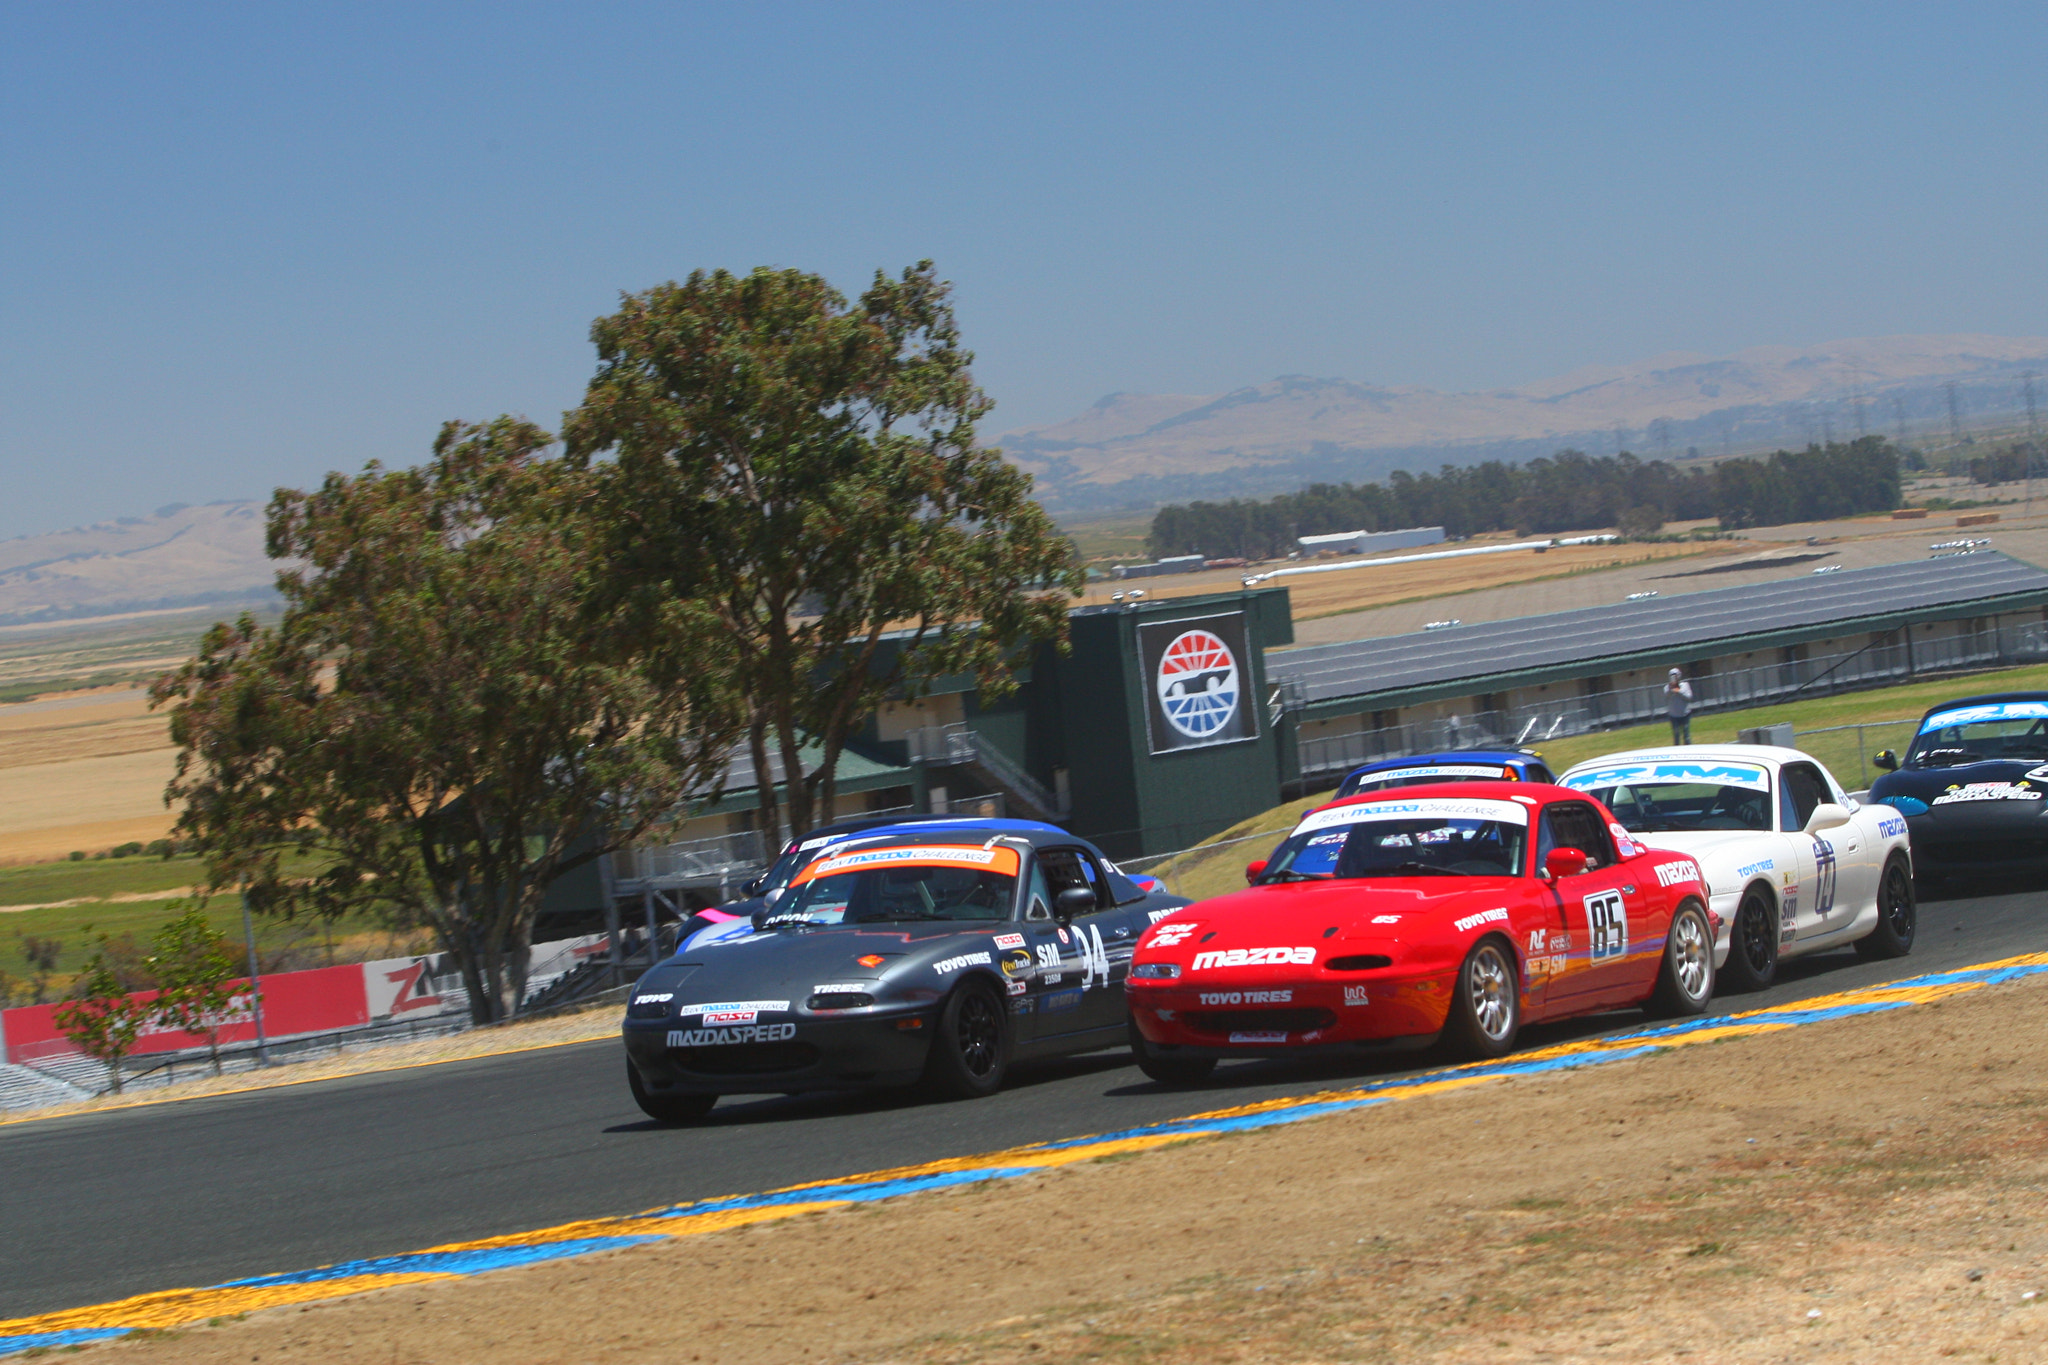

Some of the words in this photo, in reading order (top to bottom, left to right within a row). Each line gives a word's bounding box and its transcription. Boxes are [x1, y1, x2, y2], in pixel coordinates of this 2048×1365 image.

[1420, 803, 1502, 817] CHALLENGE
[913, 849, 992, 862] CHALLENGE
[1737, 863, 1760, 879] TOYO
[1757, 859, 1774, 873] TIRES
[1454, 914, 1484, 932] TOYO
[1482, 907, 1509, 922] TIRES
[1590, 896, 1624, 958] 85
[933, 957, 968, 975] TOYO
[965, 951, 992, 966] TIRES
[1036, 943, 1061, 968] SM
[1071, 924, 1110, 991] 94
[635, 993, 674, 1005] TOYO
[814, 983, 865, 994] TIRES
[1200, 991, 1242, 1005] TOYO
[1243, 990, 1293, 1003] TIRES
[666, 1023, 796, 1047] MAZDASPEED
